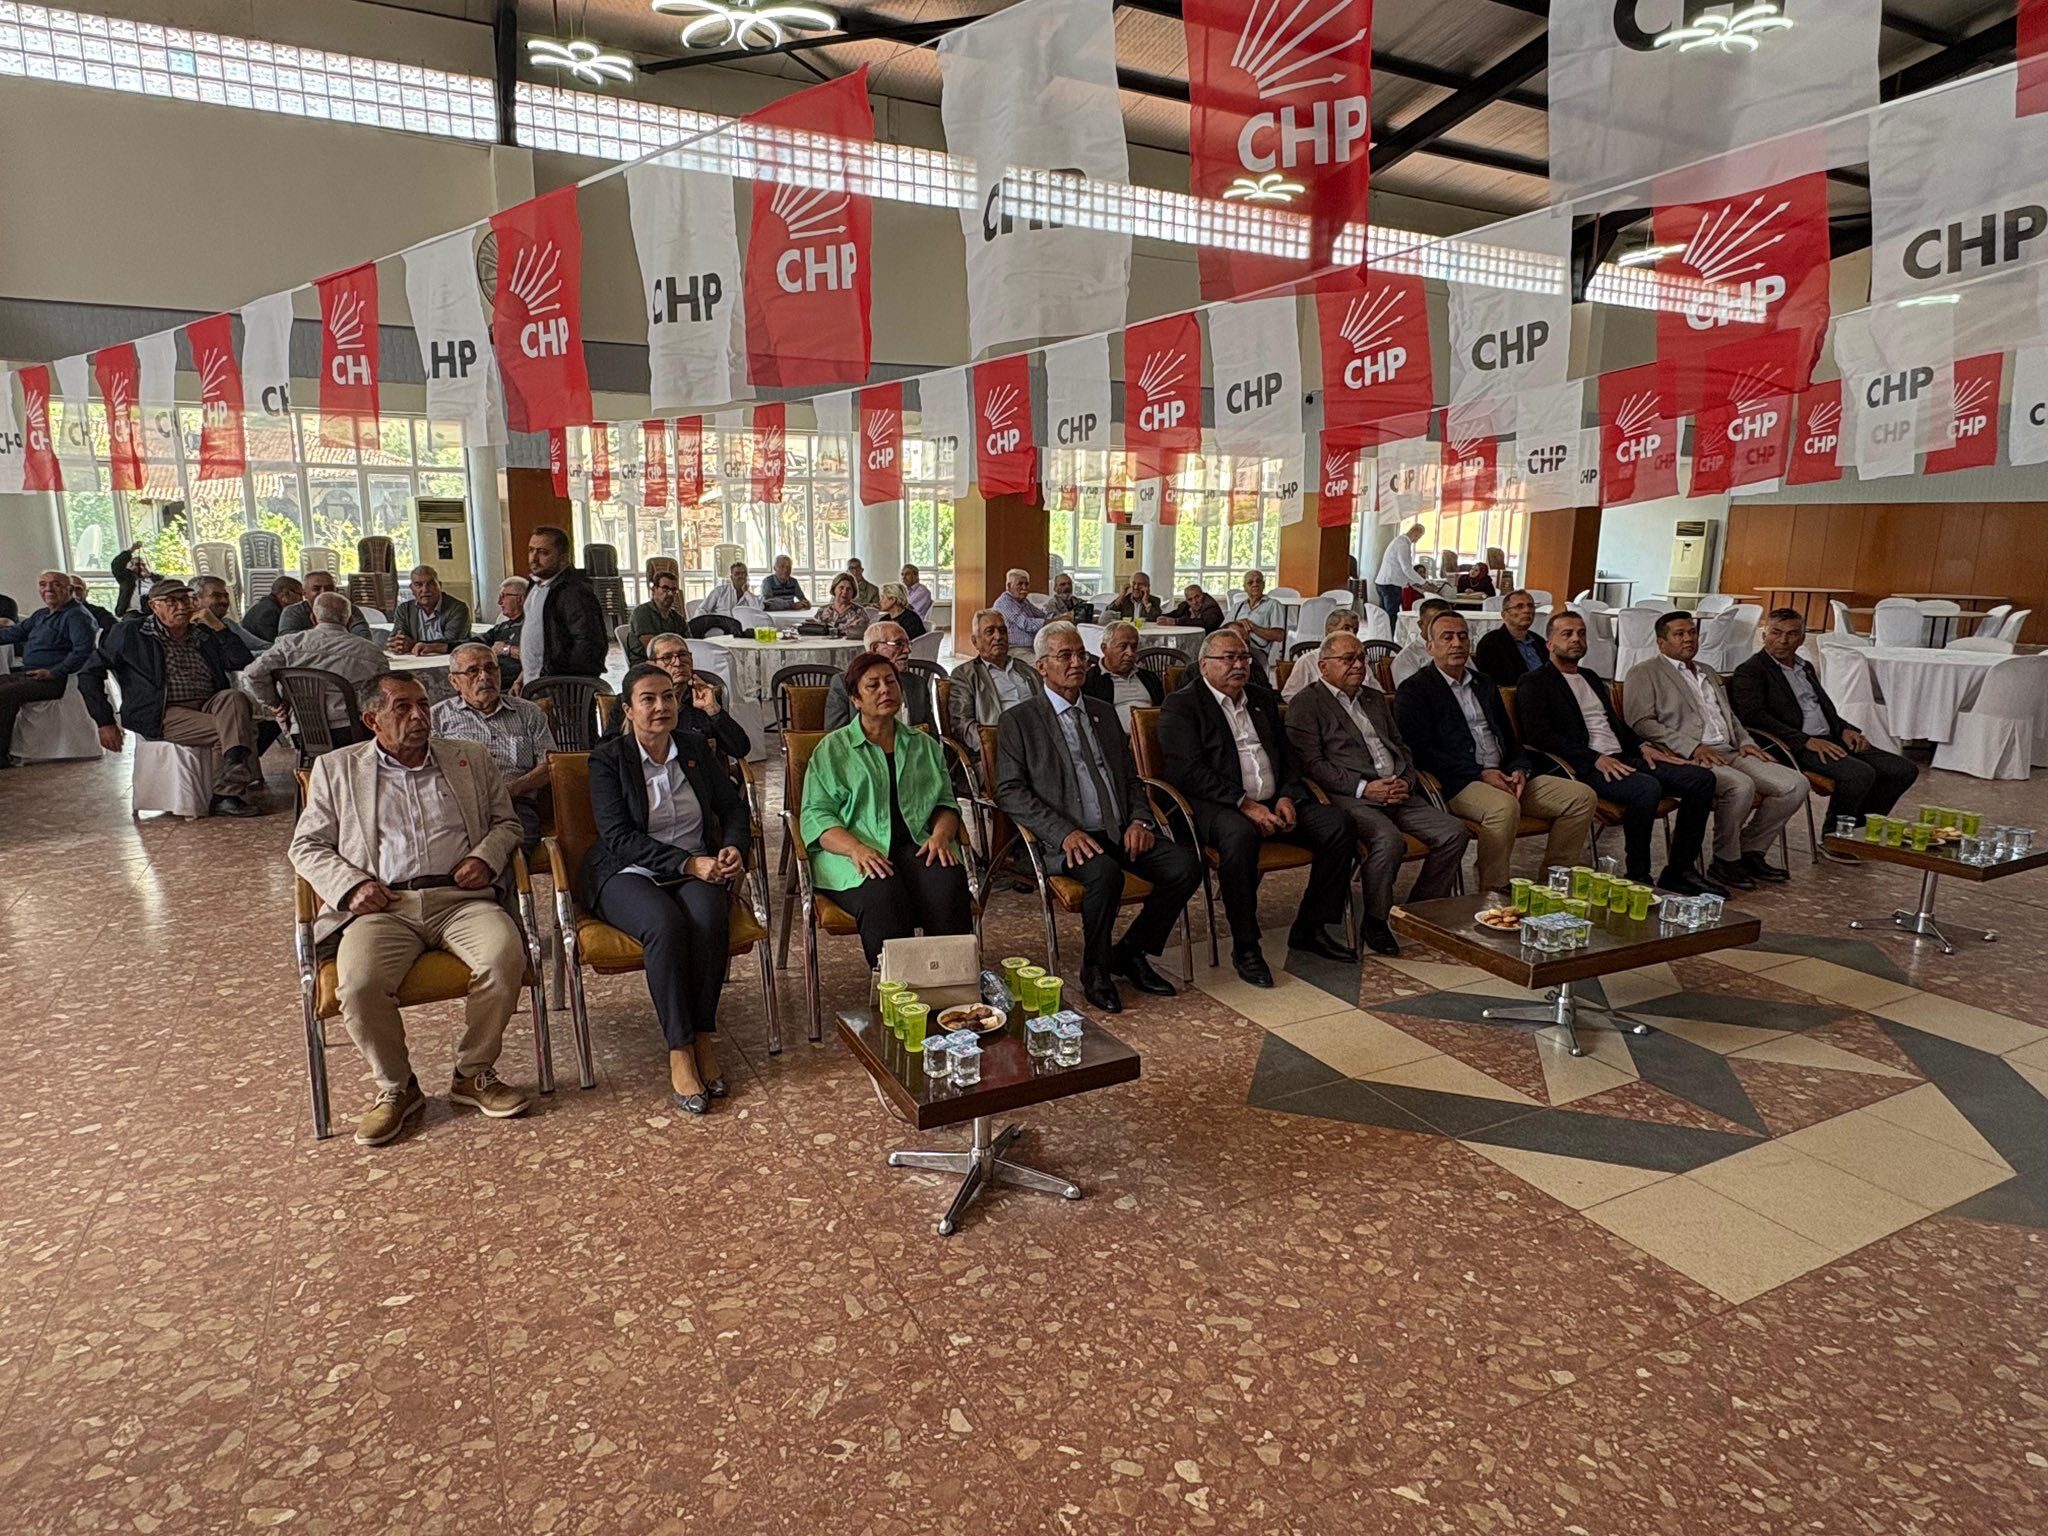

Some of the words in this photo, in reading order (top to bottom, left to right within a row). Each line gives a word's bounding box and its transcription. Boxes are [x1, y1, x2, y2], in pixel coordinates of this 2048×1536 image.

[1237, 96, 1367, 172] CHP
[1902, 205, 2048, 280] CHP
[776, 242, 858, 293] CHP
[1686, 275, 1786, 331] CHP
[520, 317, 569, 358] CHP
[1472, 320, 1549, 371] CHP
[427, 339, 477, 380] HP
[1344, 346, 1407, 389] CHP
[1226, 372, 1283, 414] CHP
[1866, 366, 1935, 409] CHP
[1057, 413, 1097, 445] CHP
[1139, 400, 1185, 432] CHP
[1727, 411, 1778, 441] CHP
[1947, 415, 1987, 439] CHP
[986, 428, 1021, 456] CHP
[1804, 435, 1838, 455] CHP
[1872, 420, 1912, 444] CHP
[868, 447, 894, 470] CHP
[1528, 445, 1567, 474] CHP
[1616, 434, 1661, 463] CHP
[1700, 455, 1725, 472] CHP
[1746, 445, 1776, 465] CHP
[1140, 487, 1155, 501] CHP
[1325, 479, 1349, 497] CHP
